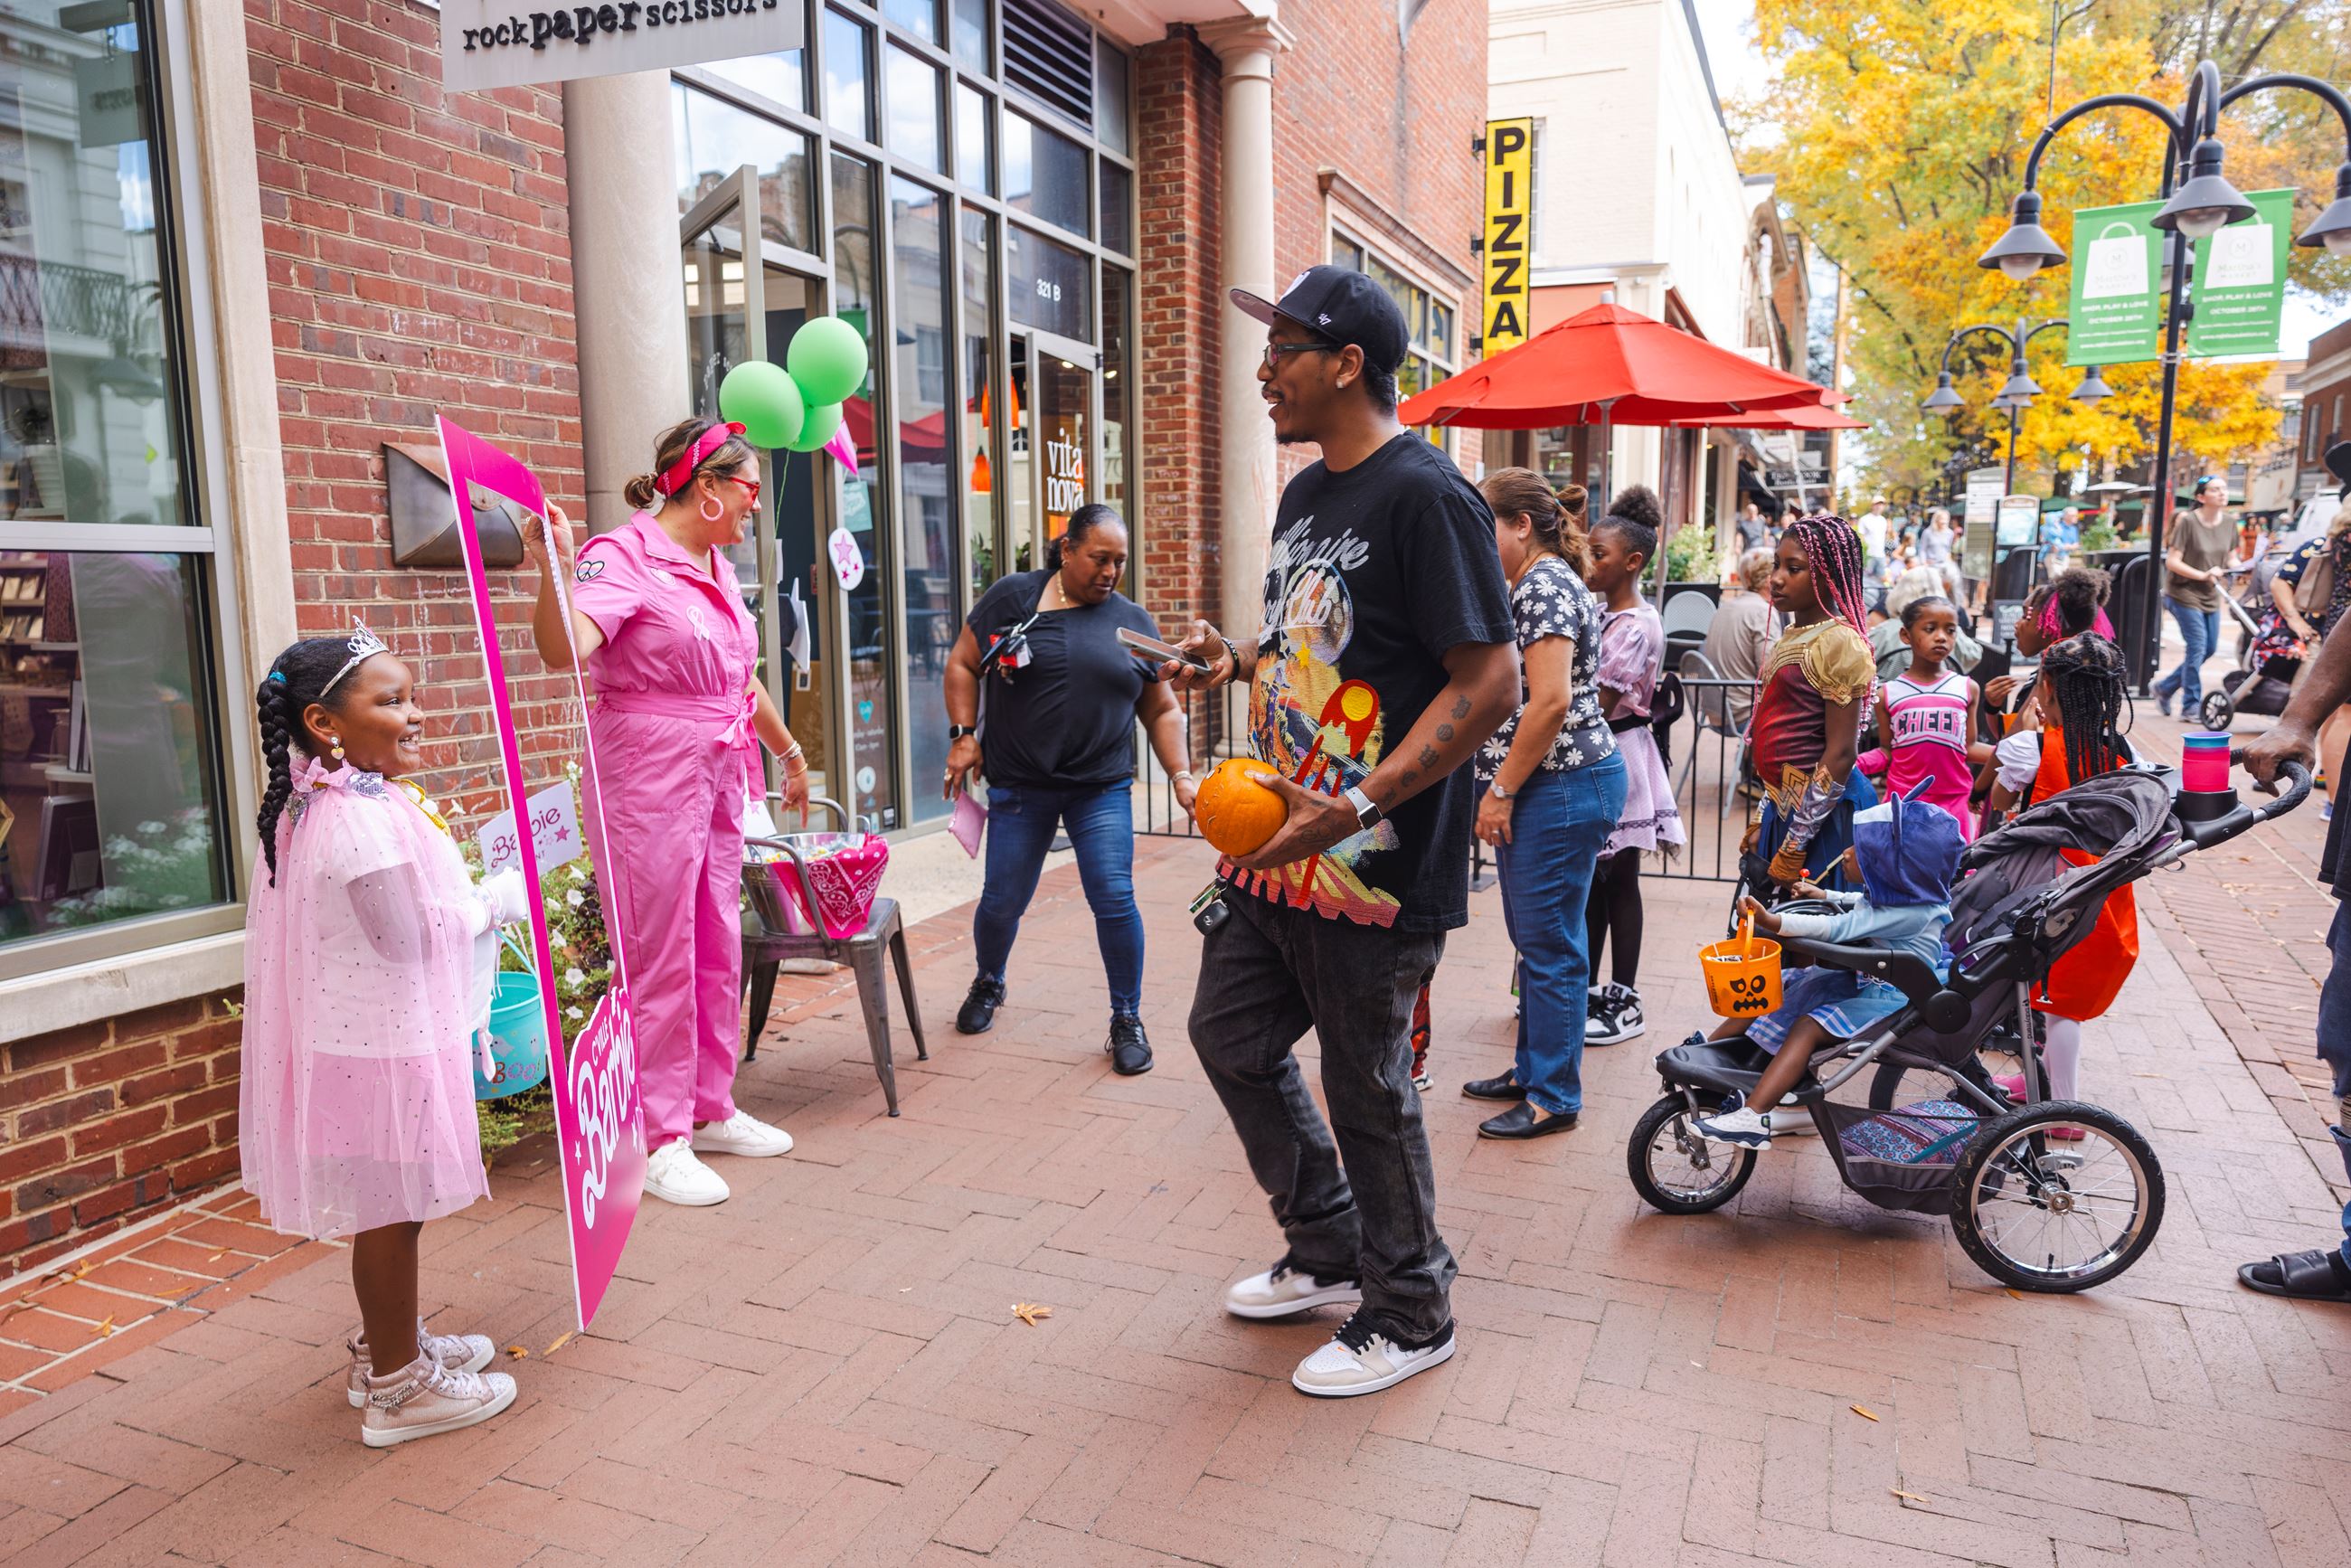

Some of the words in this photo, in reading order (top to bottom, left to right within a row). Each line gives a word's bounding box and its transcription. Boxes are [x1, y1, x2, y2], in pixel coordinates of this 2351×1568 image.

[463, 16, 529, 50] rock
[529, 2, 641, 49] paper
[1488, 127, 1525, 339] PIZZA
[1036, 279, 1052, 298] 321
[1053, 284, 1061, 301] B
[1047, 427, 1083, 479] vita
[1047, 476, 1084, 512] nova
[576, 999, 636, 1230] Barbie
